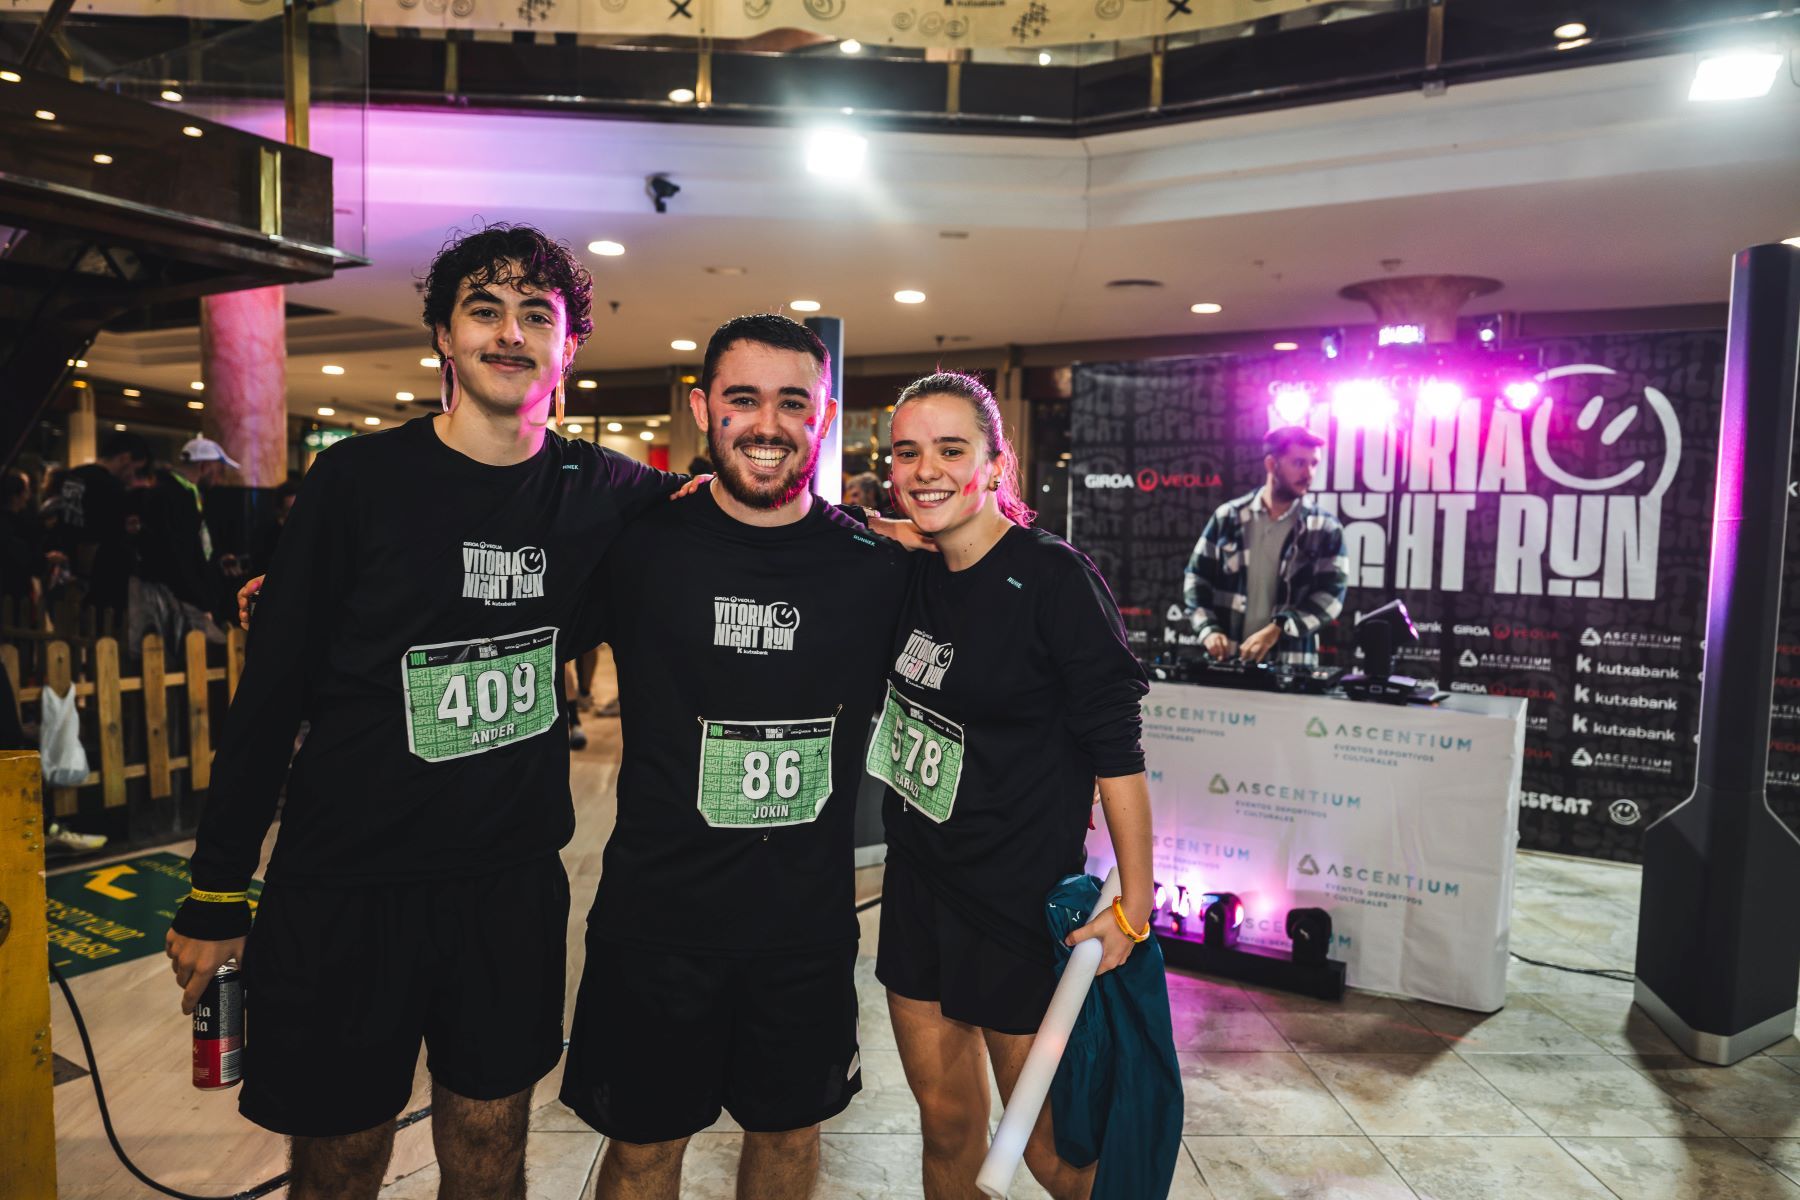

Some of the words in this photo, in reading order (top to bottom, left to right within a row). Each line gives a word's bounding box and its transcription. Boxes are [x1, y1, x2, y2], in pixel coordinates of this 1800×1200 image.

[1267, 396, 1527, 492] ITORIA
[1084, 473, 1135, 489] GIROA
[1160, 472, 1222, 488] VEOLIA
[1494, 494, 1664, 600] RUN
[462, 547, 522, 576] VITORIA
[462, 572, 508, 600] NIGHT
[512, 574, 544, 599] RUN
[714, 602, 773, 628] VITORIA
[714, 624, 760, 648] NIGHT
[762, 627, 794, 651] RUN
[1453, 624, 1490, 637] GIROA
[1512, 629, 1560, 640] VEOLIA
[1603, 632, 1682, 644] ASCENTIUM
[904, 632, 941, 666] VITORIA
[1480, 653, 1552, 666] ASCENTIUM
[921, 664, 946, 690] RUN
[1597, 662, 1680, 680] kutxabank
[437, 662, 536, 728] 409
[1451, 682, 1487, 694] GIROA
[1508, 688, 1557, 700] VEOLIA
[1594, 692, 1678, 710] kutxabank
[1141, 704, 1256, 726] ASCENTIUM
[471, 722, 515, 745] ANDER
[1142, 724, 1173, 732] VENTOS
[1335, 722, 1473, 752] ASCENTIUM
[1593, 722, 1676, 742] kutxabank
[892, 714, 942, 787] 578
[1334, 744, 1374, 754] EVENTOS
[1377, 748, 1435, 762] DEPORTIVOS
[1343, 754, 1398, 767] CULTURALES
[1595, 752, 1672, 767] ASCENTIUM
[742, 750, 800, 800] 86
[1236, 780, 1361, 808] ASCENTIUM
[752, 804, 789, 819] JOKIN
[1236, 800, 1272, 810] EVENTOS
[1275, 806, 1327, 819] DEPORTIVOS
[1243, 810, 1294, 823] CULTURALES
[1153, 836, 1249, 861] SCENTIUM
[1327, 863, 1460, 896] ASCENTIUM
[1326, 883, 1364, 896] EVENTOS
[1367, 890, 1423, 906] DEPORTIVOS
[1334, 894, 1388, 908] CULTURALES
